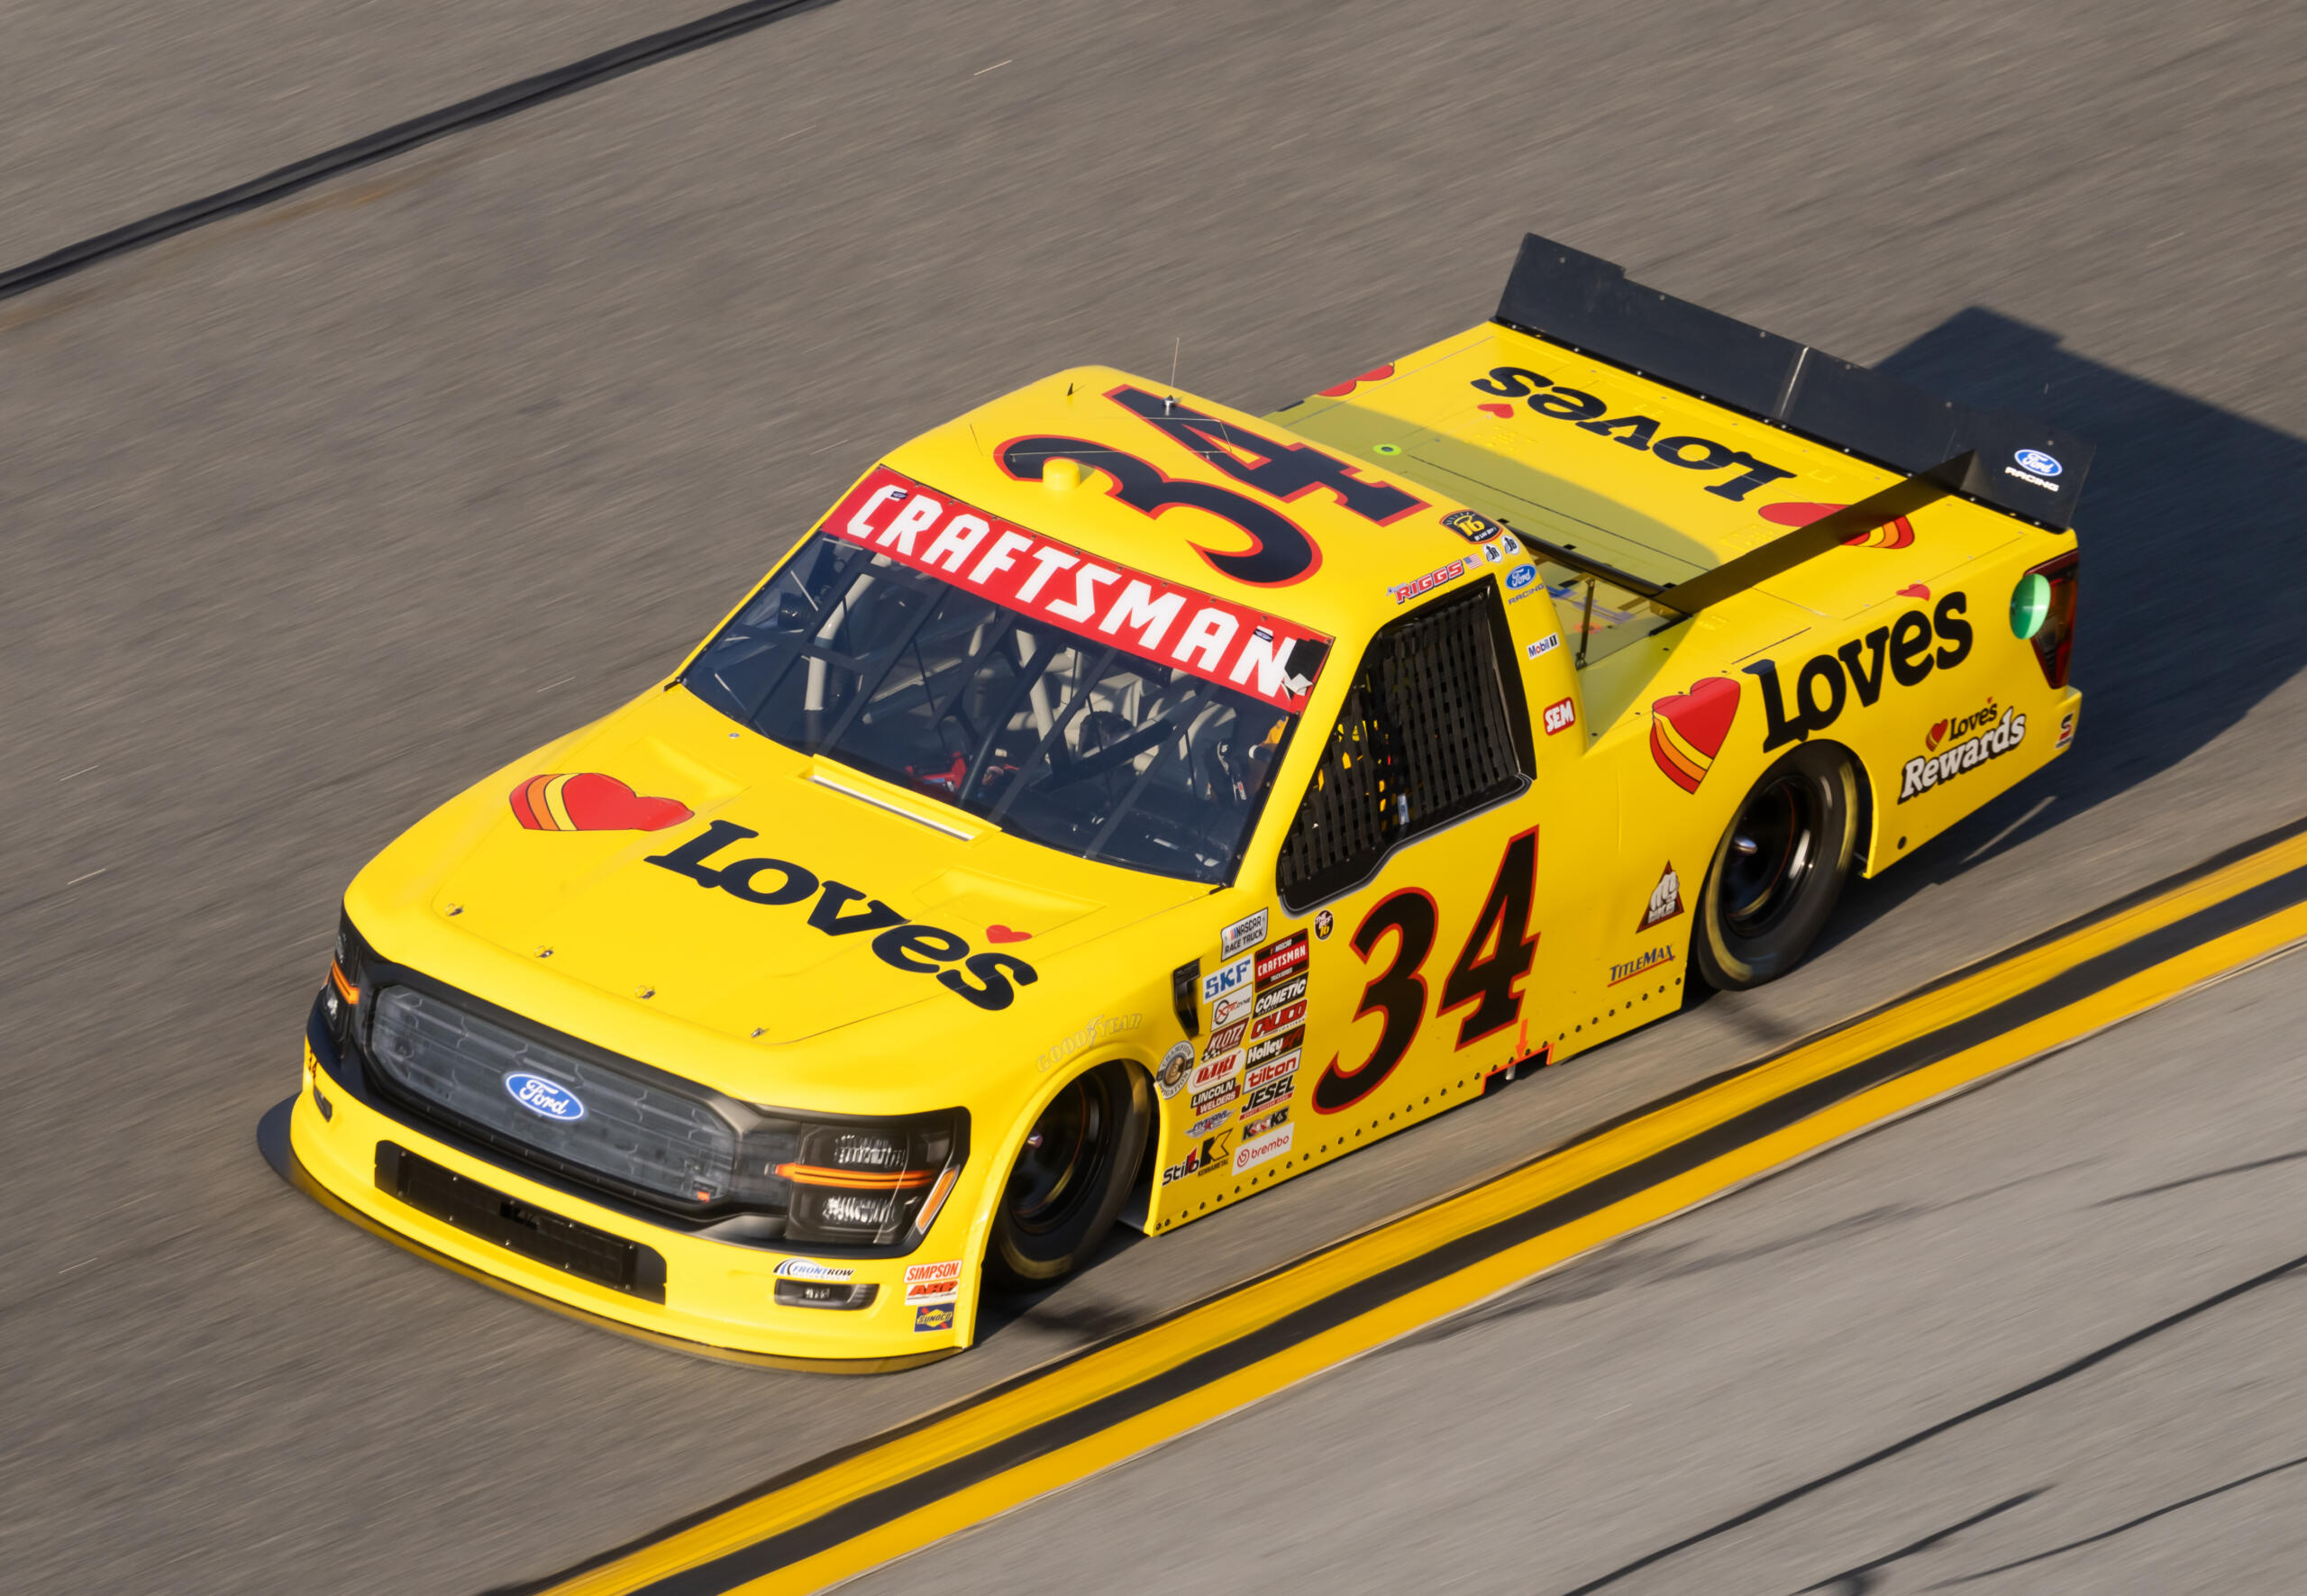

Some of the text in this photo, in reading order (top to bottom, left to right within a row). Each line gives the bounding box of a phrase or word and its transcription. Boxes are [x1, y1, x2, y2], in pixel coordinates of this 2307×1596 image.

[993, 384, 1433, 588] 34
[2004, 466, 2059, 492] RACING
[847, 484, 1298, 700] CRAFTSMAN
[1395, 559, 1464, 605] RIGGS
[1508, 582, 1545, 605] RACING
[1528, 638, 1550, 657] Mobil
[1546, 700, 1573, 731] SEM
[1897, 706, 2027, 805] Rewards
[1225, 928, 1263, 954] RACE TRUCK
[1236, 916, 1262, 938] NASCAR
[1257, 944, 1306, 977] CRAFTSMAN
[1312, 824, 1541, 1115] 34
[1205, 959, 1251, 1000] SKF
[1254, 979, 1307, 1014] COMETIC
[1251, 999, 1307, 1039] CALICO
[1208, 1022, 1245, 1053] KLOTZ
[1247, 1037, 1283, 1064] Holley
[1196, 1053, 1238, 1083] DART
[1248, 1057, 1296, 1088] tilton
[519, 1080, 570, 1114] Ford
[1192, 1080, 1234, 1105] LINCOLN
[1199, 1091, 1236, 1113] WELDERS
[1242, 1074, 1295, 1113] JESEL
[1243, 1106, 1289, 1141] KOOKS
[1252, 1135, 1289, 1159] brembo
[907, 1262, 959, 1281] SIMPSON
[908, 1281, 958, 1296] ARP
[916, 1312, 952, 1325] SUNOCO
